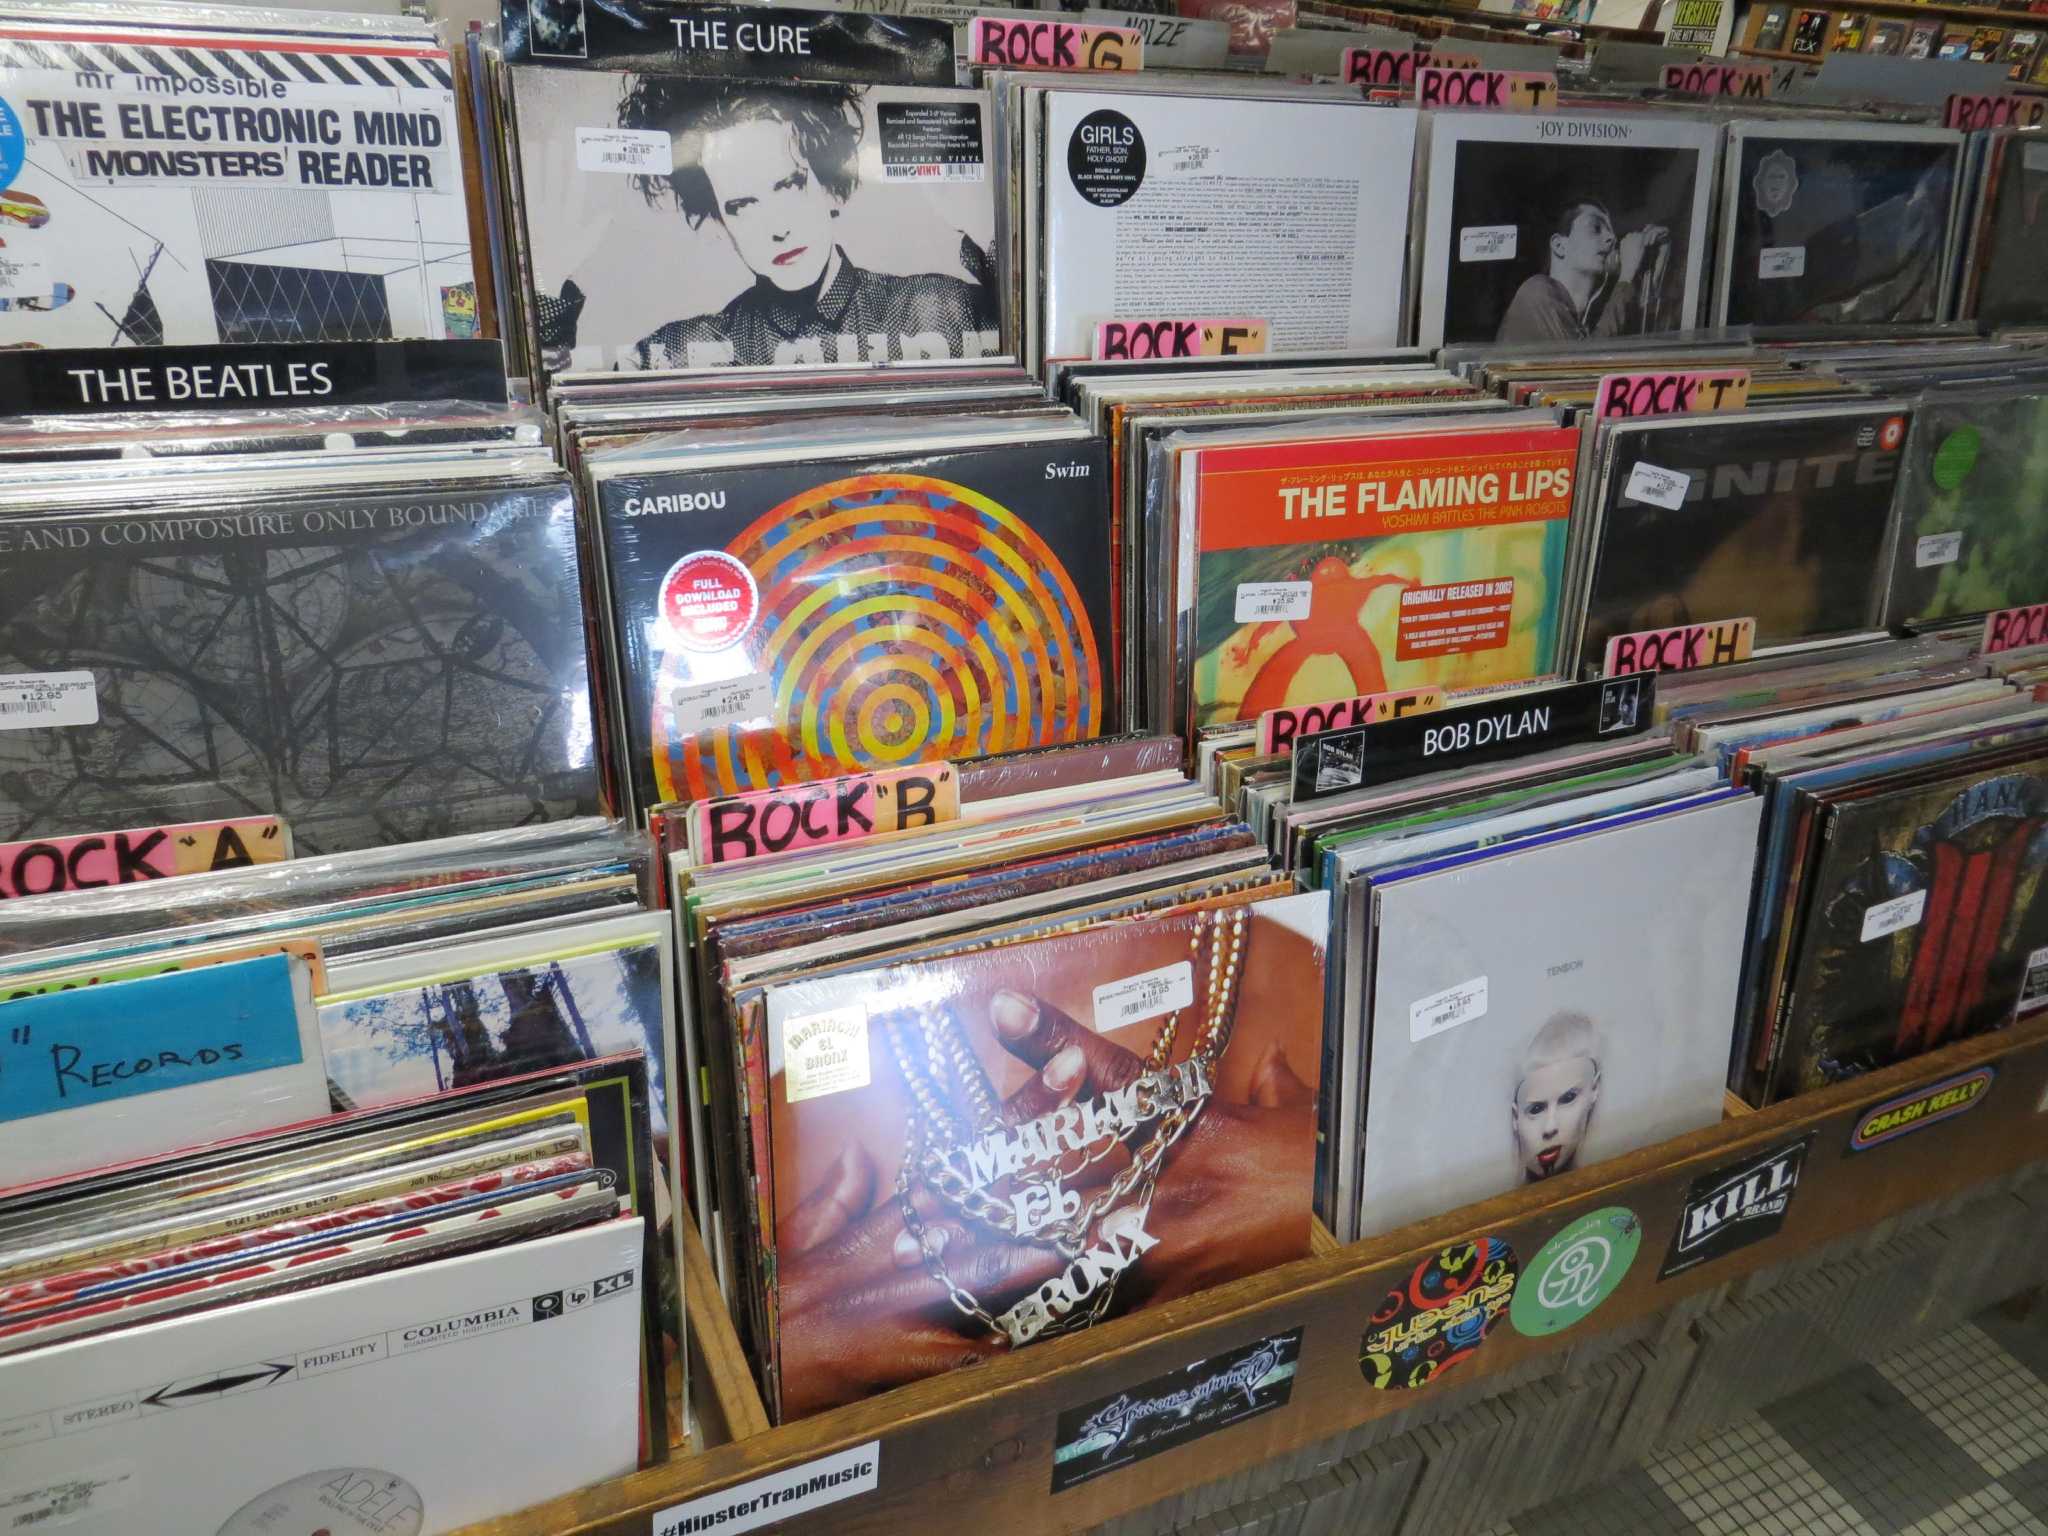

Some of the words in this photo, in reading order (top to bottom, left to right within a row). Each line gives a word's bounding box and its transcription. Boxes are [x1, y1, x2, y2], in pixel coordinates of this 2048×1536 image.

[670, 19, 728, 50] THE
[736, 23, 811, 55] CURE
[981, 20, 1075, 67] ROCK
[75, 71, 115, 90] mr
[136, 73, 288, 99] impossible
[1422, 71, 1505, 107] ROCK
[1666, 66, 1735, 97] ROCK
[27, 100, 106, 139] THE
[119, 104, 341, 147] ELECTRONIC
[354, 109, 443, 148] MIND
[1080, 125, 1135, 145] GIRLS
[300, 151, 433, 189] READER
[1087, 155, 1104, 163] HOLY
[1105, 156, 1128, 164] GHOST
[1104, 322, 1196, 360] ROCK
[68, 367, 157, 403] THE
[166, 362, 334, 400] BEATLES
[1605, 377, 1696, 417] ROCK
[1045, 461, 1091, 482] Swim
[625, 491, 726, 517] CARIBOU
[1278, 485, 1348, 520] THE
[1357, 474, 1499, 514] FLAMING
[1507, 468, 1571, 502] LIPS
[21, 527, 90, 551] AND
[101, 513, 295, 545] COMPOSURE
[303, 507, 378, 532] ONLY
[1432, 509, 1475, 524] BATTLES
[1478, 507, 1498, 520] THE
[675, 588, 741, 605] DOWNLOAD
[692, 578, 722, 589] FULL
[1402, 587, 1446, 606] ORIGINALLY
[1447, 584, 1484, 601] RELEASED
[1485, 583, 1494, 596] IN
[1615, 634, 1704, 674] ROCK
[1271, 698, 1373, 754] ROCK
[1423, 723, 1470, 756] BOB
[1475, 706, 1551, 743] DYLAN
[1322, 743, 1335, 753] BOB
[1336, 748, 1354, 760] DYLAN
[710, 780, 873, 864] ROCK
[0, 829, 168, 899] OCK
[788, 1018, 861, 1050] MARIACHI
[806, 1049, 849, 1071] BRONX
[960, 1056, 1213, 1191] MARIACHI
[1863, 1101, 1924, 1137] CRASH
[1927, 1080, 1983, 1112] KELLY
[255, 1204, 300, 1220] SUNSET
[1687, 1160, 1793, 1239] KILL
[1743, 1198, 1784, 1217] BRAND
[596, 1275, 632, 1296] XL
[1005, 1202, 1160, 1348] BRONX
[403, 1305, 520, 1342] COLUMBIA
[303, 1342, 378, 1370] FIDELITY
[63, 1400, 135, 1425] STEREO
[658, 1459, 874, 1536] #HipsterTrapMusic
